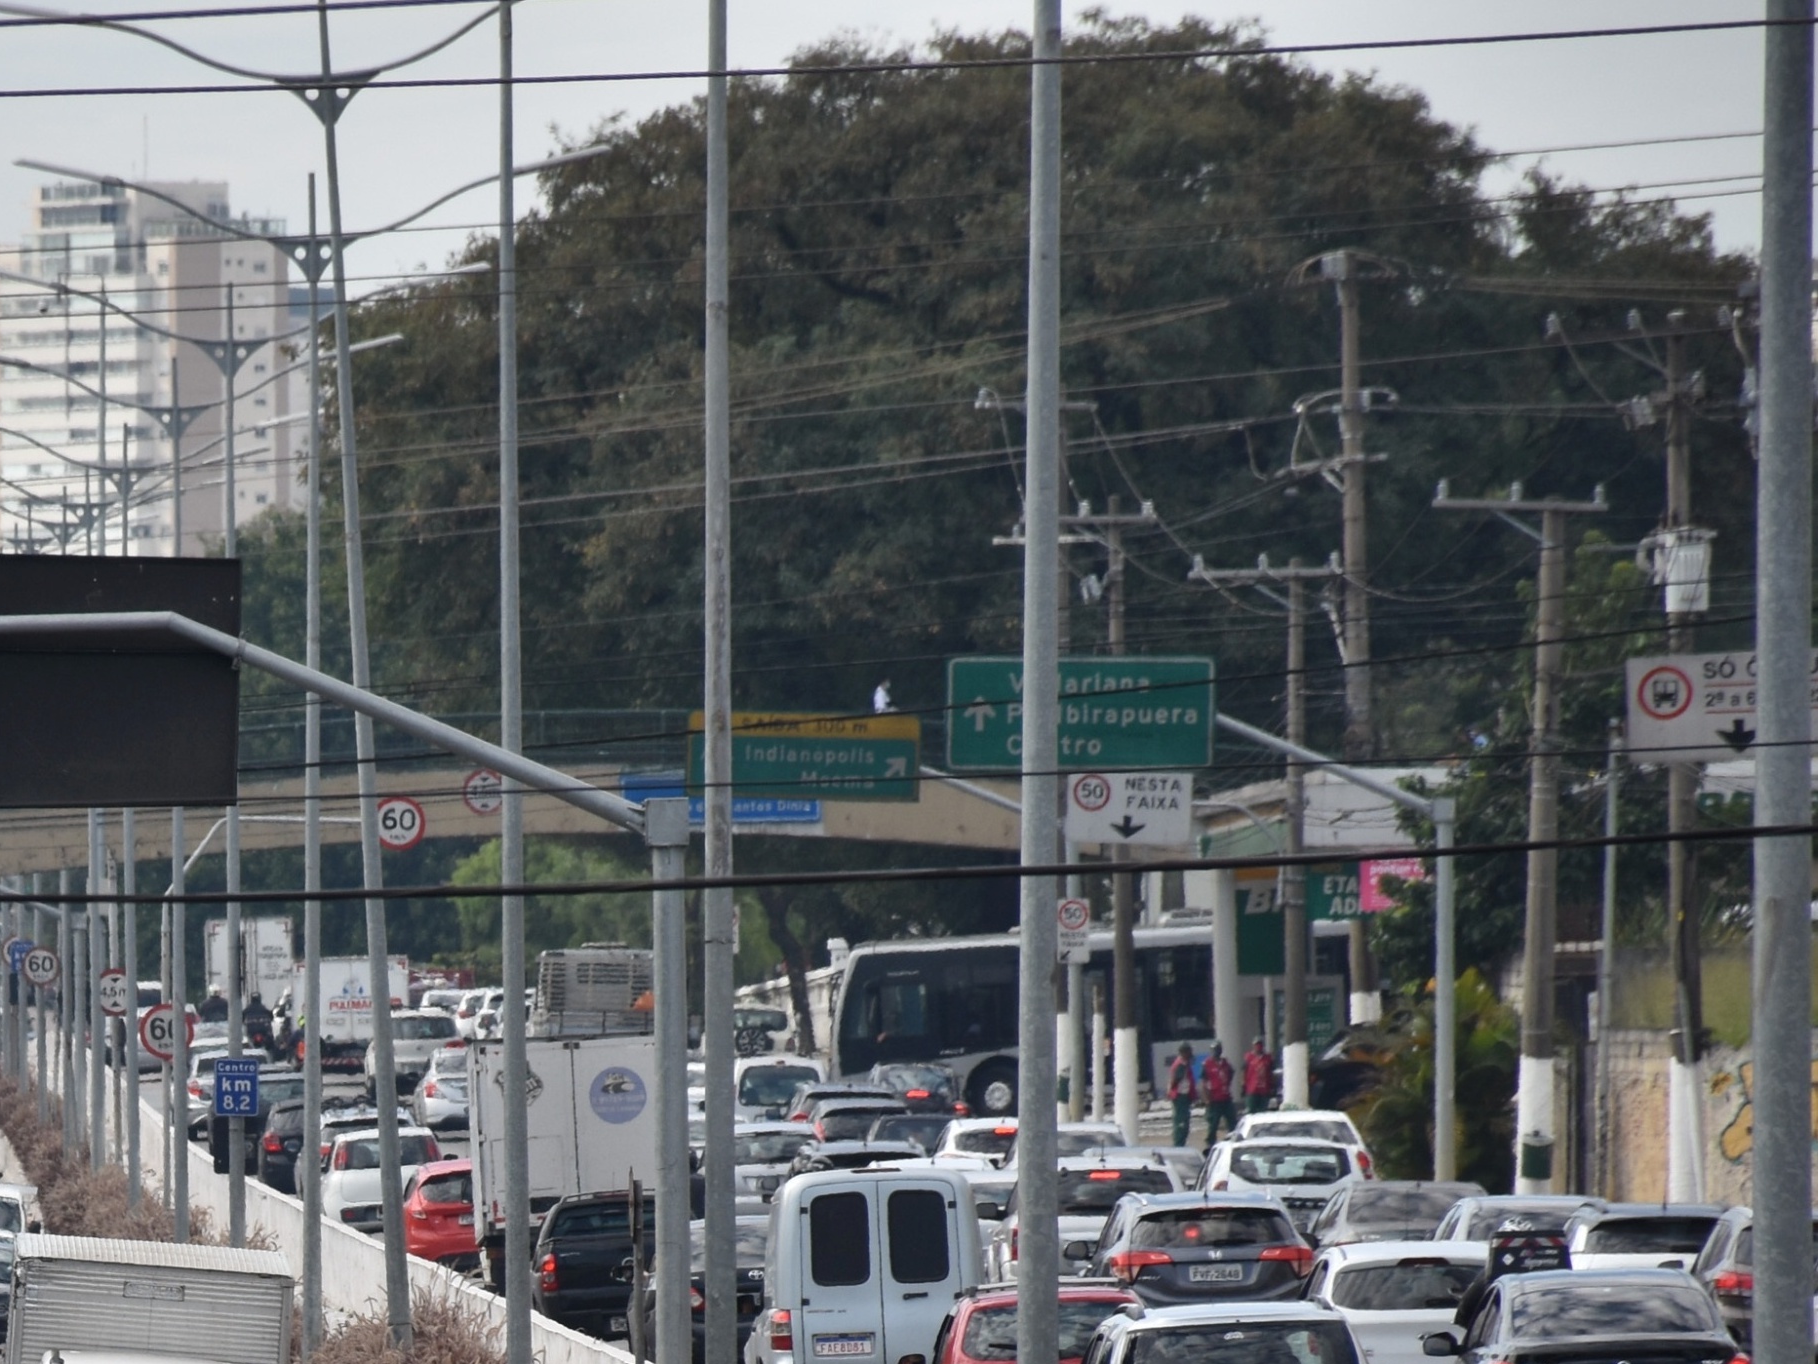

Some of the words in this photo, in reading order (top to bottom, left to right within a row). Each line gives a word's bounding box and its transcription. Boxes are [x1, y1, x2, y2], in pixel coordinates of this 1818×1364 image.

[1703, 656, 1736, 680] SÓ
[1057, 673, 1151, 695] ariana
[1730, 694, 1741, 706] a
[852, 721, 868, 733] m
[1006, 735, 1102, 755] Ctro
[1081, 783, 1104, 799] 50
[1124, 778, 1182, 792] NESTA
[1126, 796, 1179, 810] FAIXA
[382, 808, 417, 831] 60
[1063, 906, 1083, 920] 50
[28, 956, 54, 973] 60
[217, 1062, 256, 1072] Centro
[222, 1076, 251, 1092] km
[223, 1094, 250, 1112] 8,2
